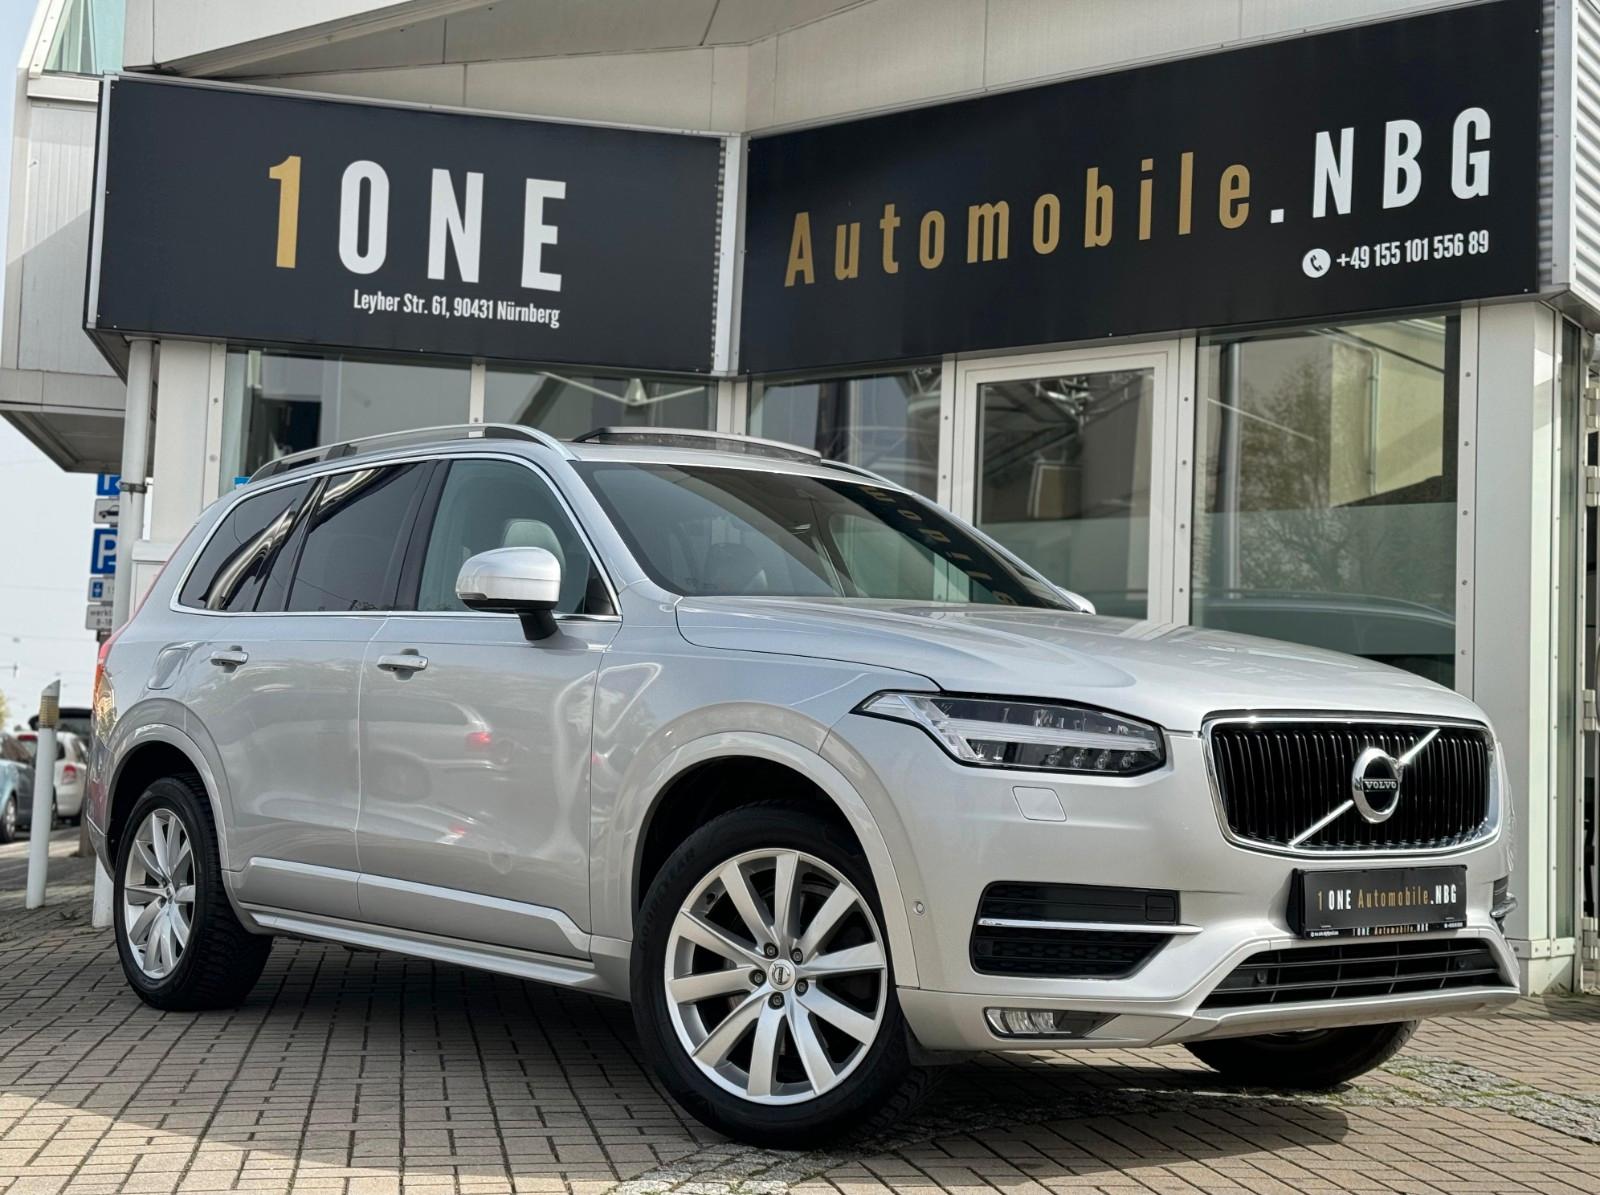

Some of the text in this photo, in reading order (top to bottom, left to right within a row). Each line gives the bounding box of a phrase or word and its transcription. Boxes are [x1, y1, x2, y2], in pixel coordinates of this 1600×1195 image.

[269, 155, 567, 292] 1 ONE
[1336, 229, 1490, 269] +49 155 101 556 89
[353, 288, 561, 329] Leyher Str. 61, 90431 Nürnberg
[1364, 781, 1397, 789] VOLVO
[1317, 891, 1324, 911] 1
[1328, 889, 1352, 911] ONE
